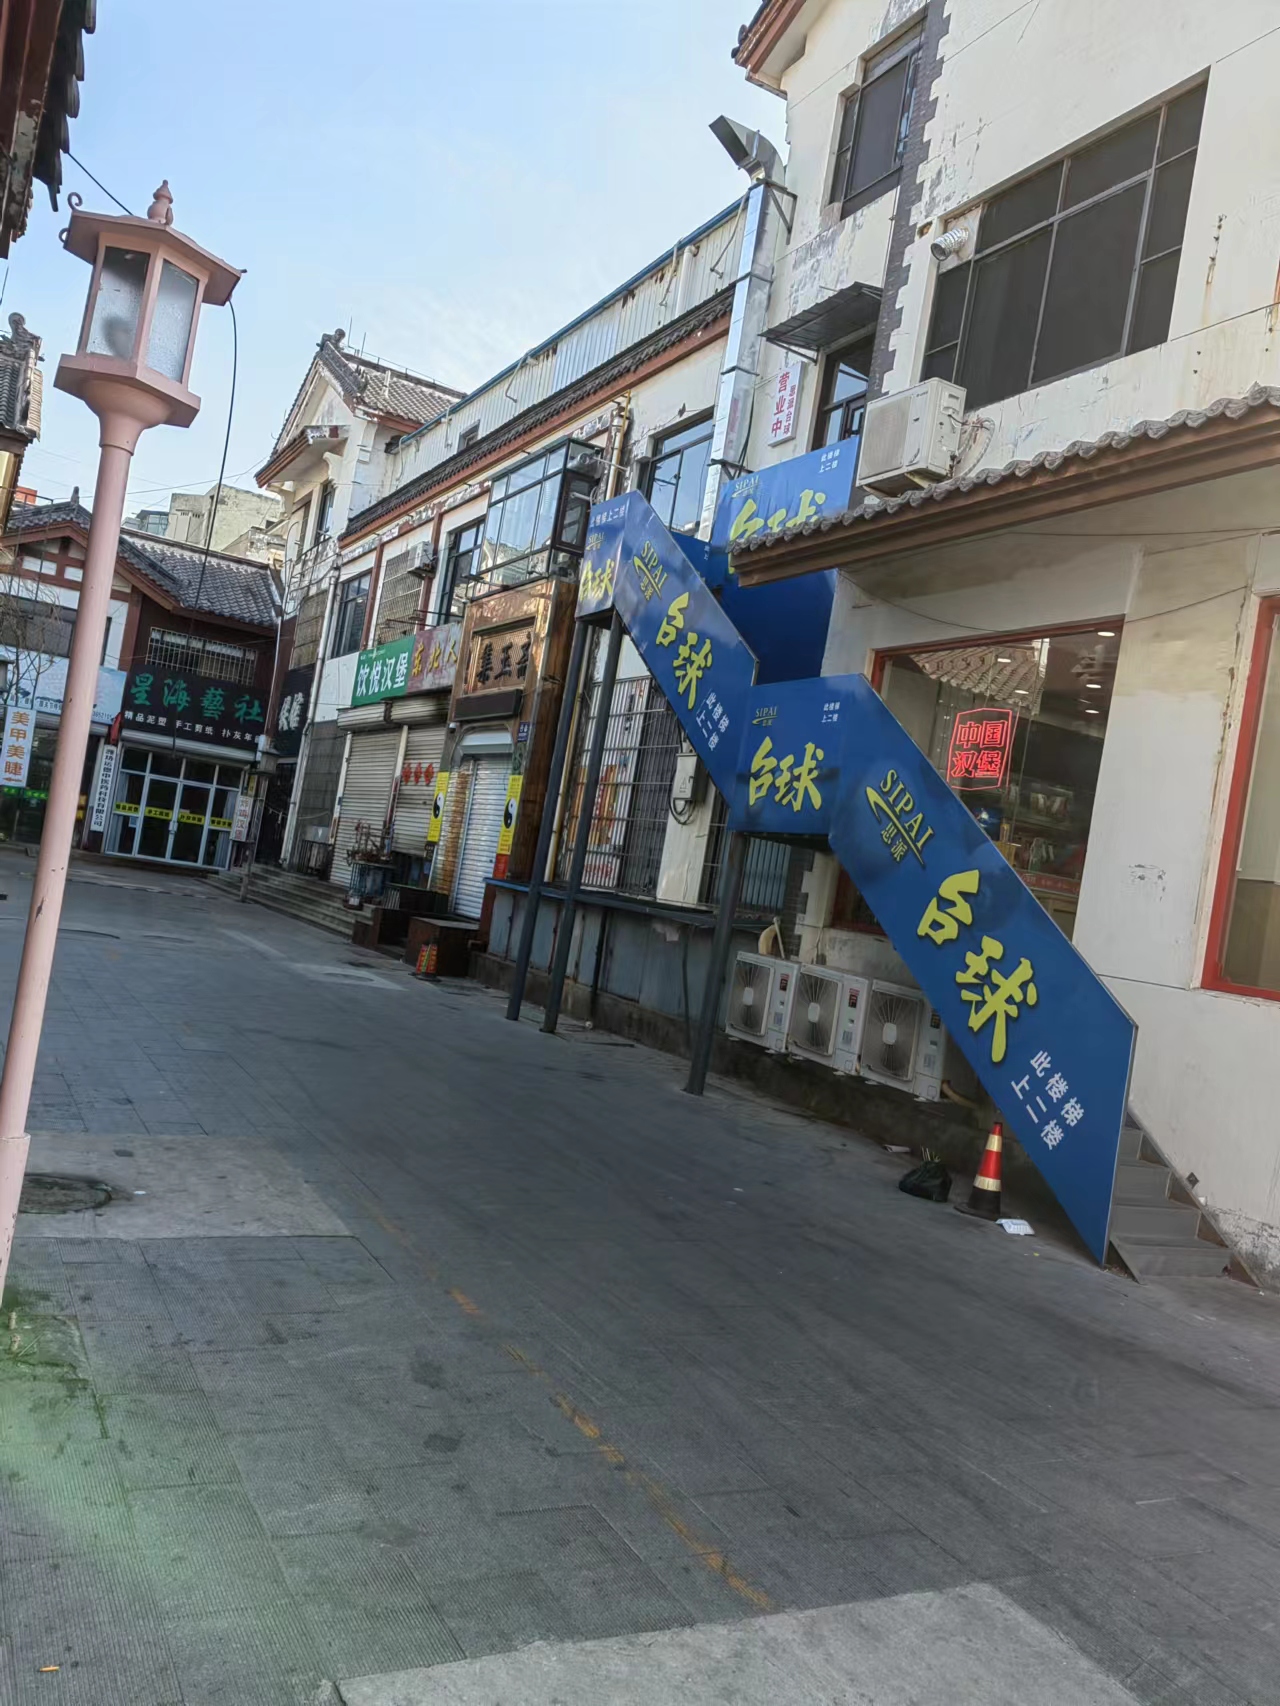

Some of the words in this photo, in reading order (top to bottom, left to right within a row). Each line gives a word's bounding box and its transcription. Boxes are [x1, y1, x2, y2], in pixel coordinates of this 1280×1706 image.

[771, 371, 791, 438] 营业中
[819, 460, 838, 474] 上二楼
[820, 449, 840, 462] 此楼梯
[579, 558, 616, 601] 台球
[641, 540, 668, 590] SIPAI
[655, 591, 713, 710] 台球
[124, 710, 168, 727] 精品泥塑
[174, 720, 214, 736] 手工剪纸
[696, 710, 720, 752] 上二楼
[705, 692, 730, 733] 此楼梯
[755, 706, 778, 718] SIPAI
[4, 711, 30, 776] 美甲美睫
[956, 720, 1008, 748] 中国
[748, 735, 825, 813] 台球
[951, 750, 1002, 779] 汉堡
[880, 769, 934, 850] SIPAI
[880, 823, 910, 863] 思派
[916, 869, 1038, 1063] 台球
[1030, 1050, 1086, 1129] 此楼梯
[1011, 1078, 1065, 1152] 上二楼
